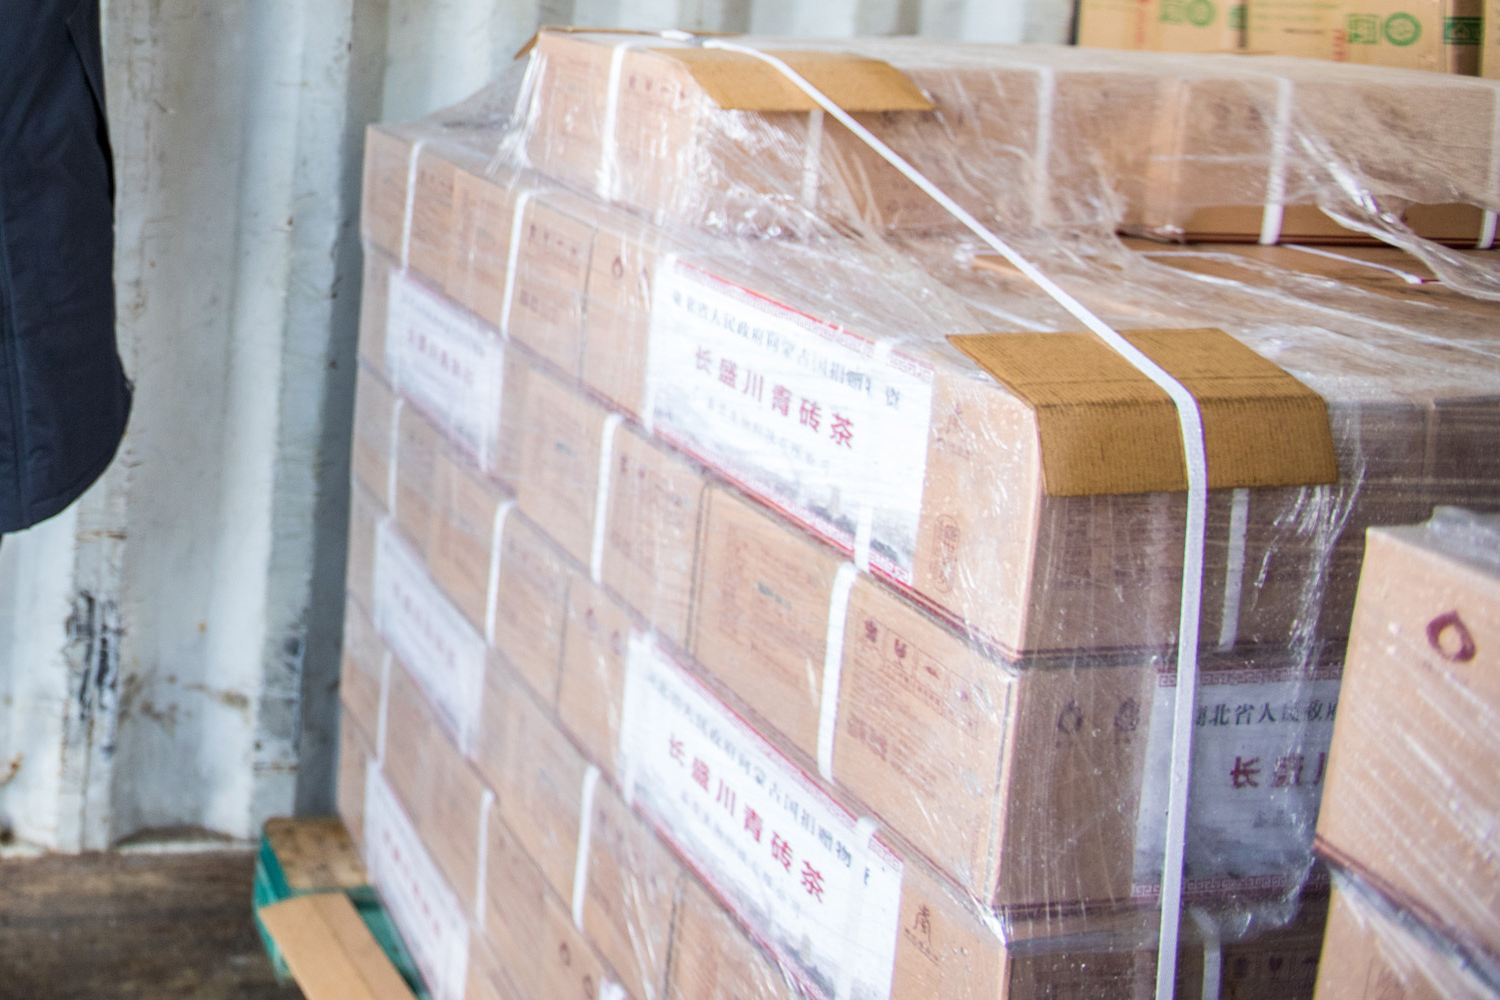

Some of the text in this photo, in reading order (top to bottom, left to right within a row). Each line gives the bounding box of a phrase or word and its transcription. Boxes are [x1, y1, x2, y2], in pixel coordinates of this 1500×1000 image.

[694, 345, 855, 450] 长盛川青砖茶
[668, 730, 825, 904] 长盛川青砖茶
